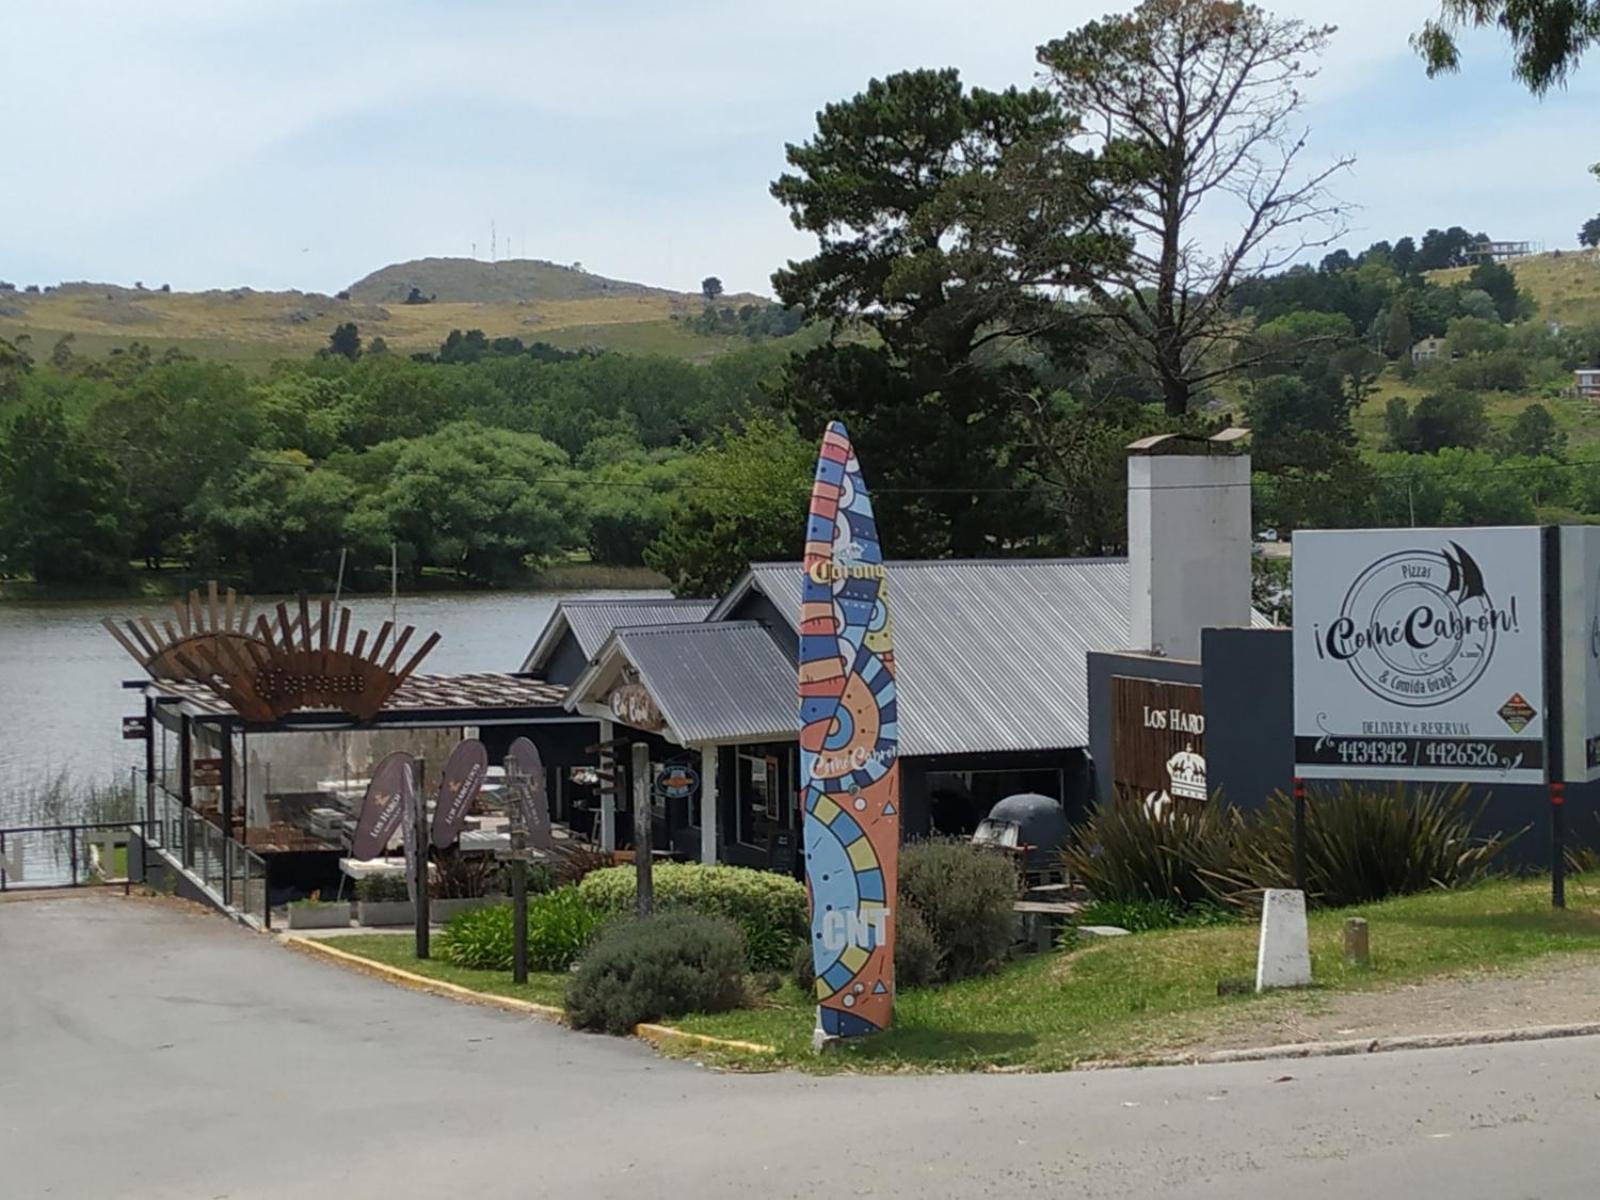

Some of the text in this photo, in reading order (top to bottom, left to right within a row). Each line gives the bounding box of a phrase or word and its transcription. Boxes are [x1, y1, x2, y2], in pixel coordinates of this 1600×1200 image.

[1401, 564, 1432, 579] Pizzas
[1391, 675, 1426, 693] Comida
[1362, 721, 1409, 734] DELIVERY
[1421, 722, 1471, 735] RESERVAS
[1338, 741, 1407, 763] 4434342
[1426, 743, 1498, 765] 4426526
[823, 908, 890, 950] CNT
